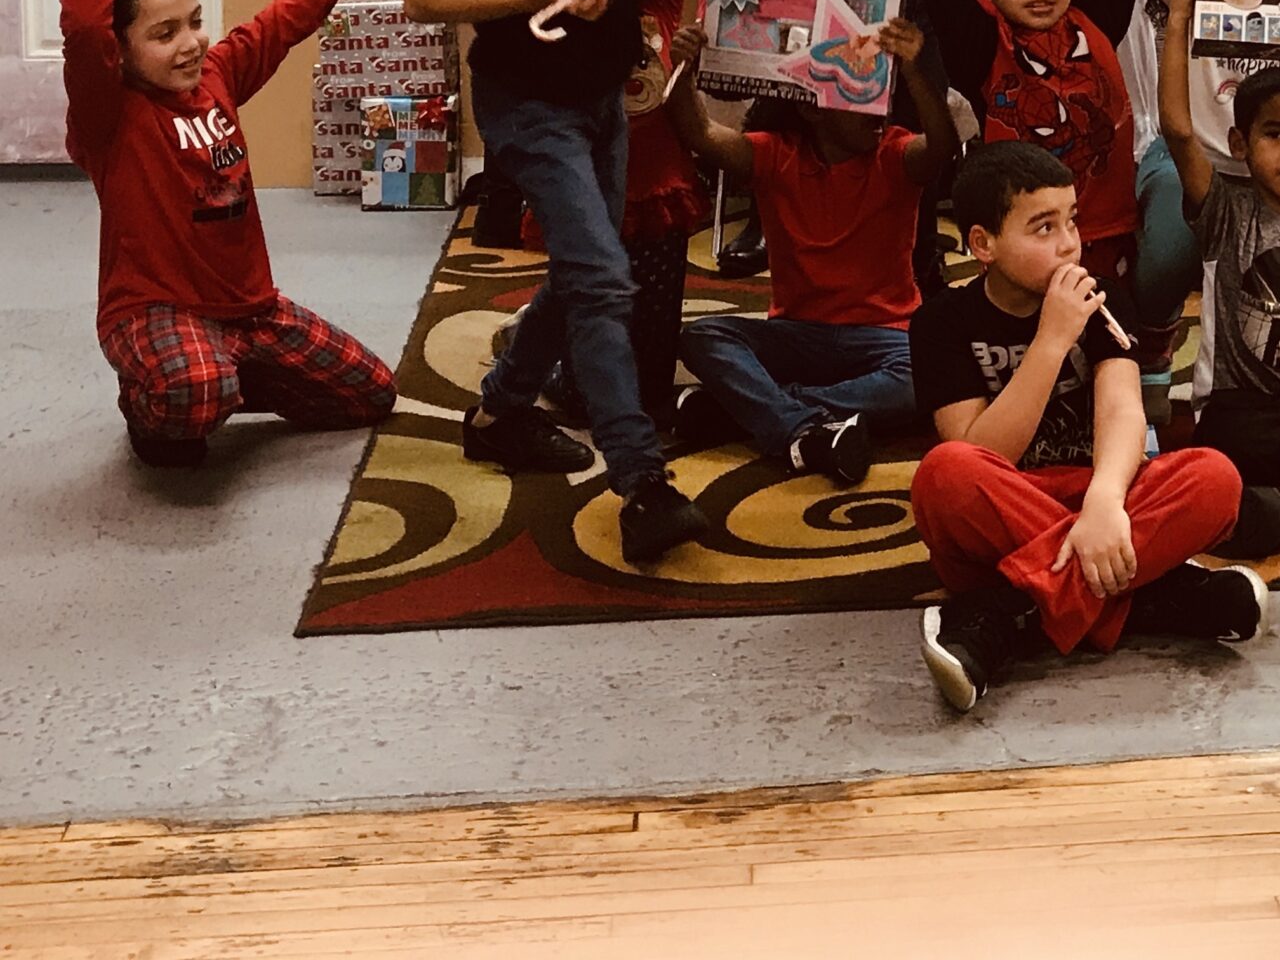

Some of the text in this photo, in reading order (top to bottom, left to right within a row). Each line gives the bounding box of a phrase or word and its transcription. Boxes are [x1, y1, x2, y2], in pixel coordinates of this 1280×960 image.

[319, 35, 390, 52] santa
[371, 56, 444, 73] santa
[322, 82, 392, 99] santa
[173, 108, 236, 150] NICE
